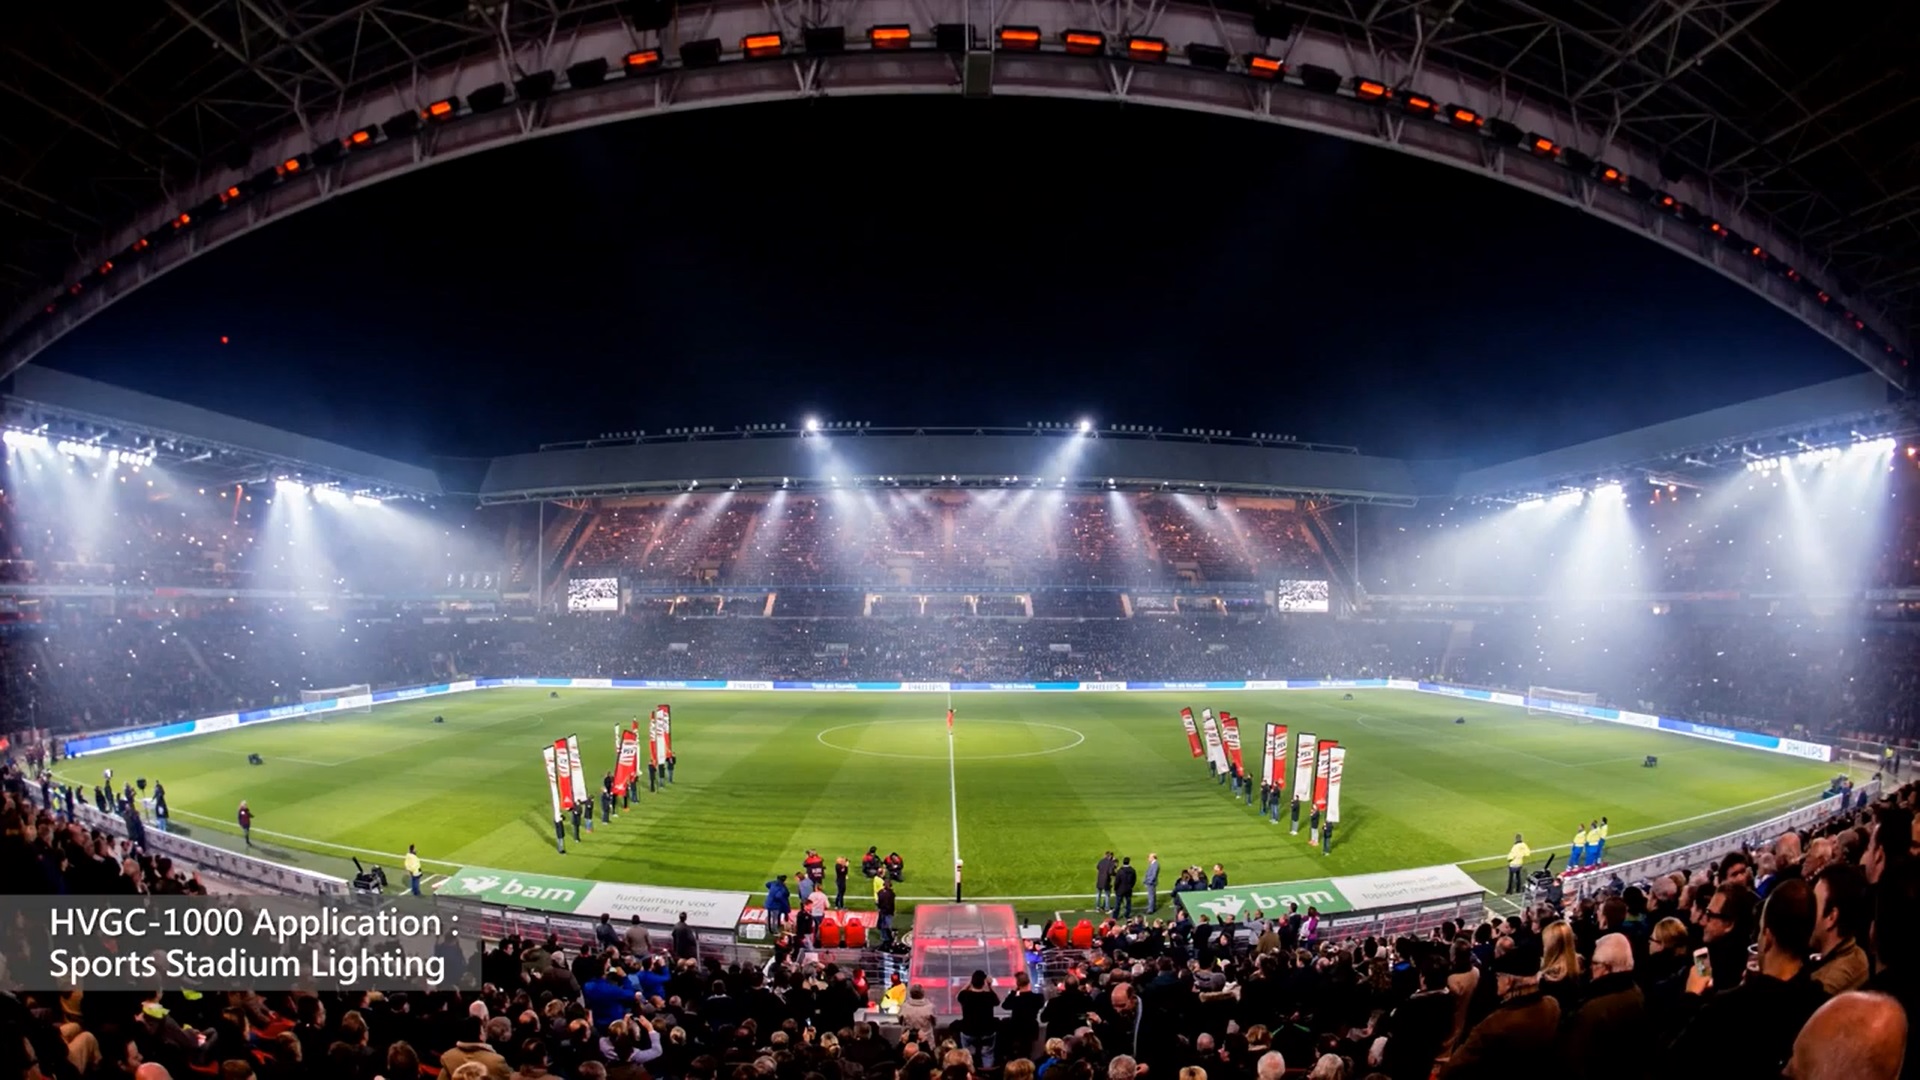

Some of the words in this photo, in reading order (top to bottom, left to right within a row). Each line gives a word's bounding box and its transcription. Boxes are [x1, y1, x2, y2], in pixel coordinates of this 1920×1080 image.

[1786, 742, 1824, 758] PHILIPS
[501, 878, 575, 902] bam
[616, 894, 685, 906] fundament
[1251, 890, 1334, 909] bam
[611, 903, 660, 914] sportief
[662, 908, 709, 917] suces
